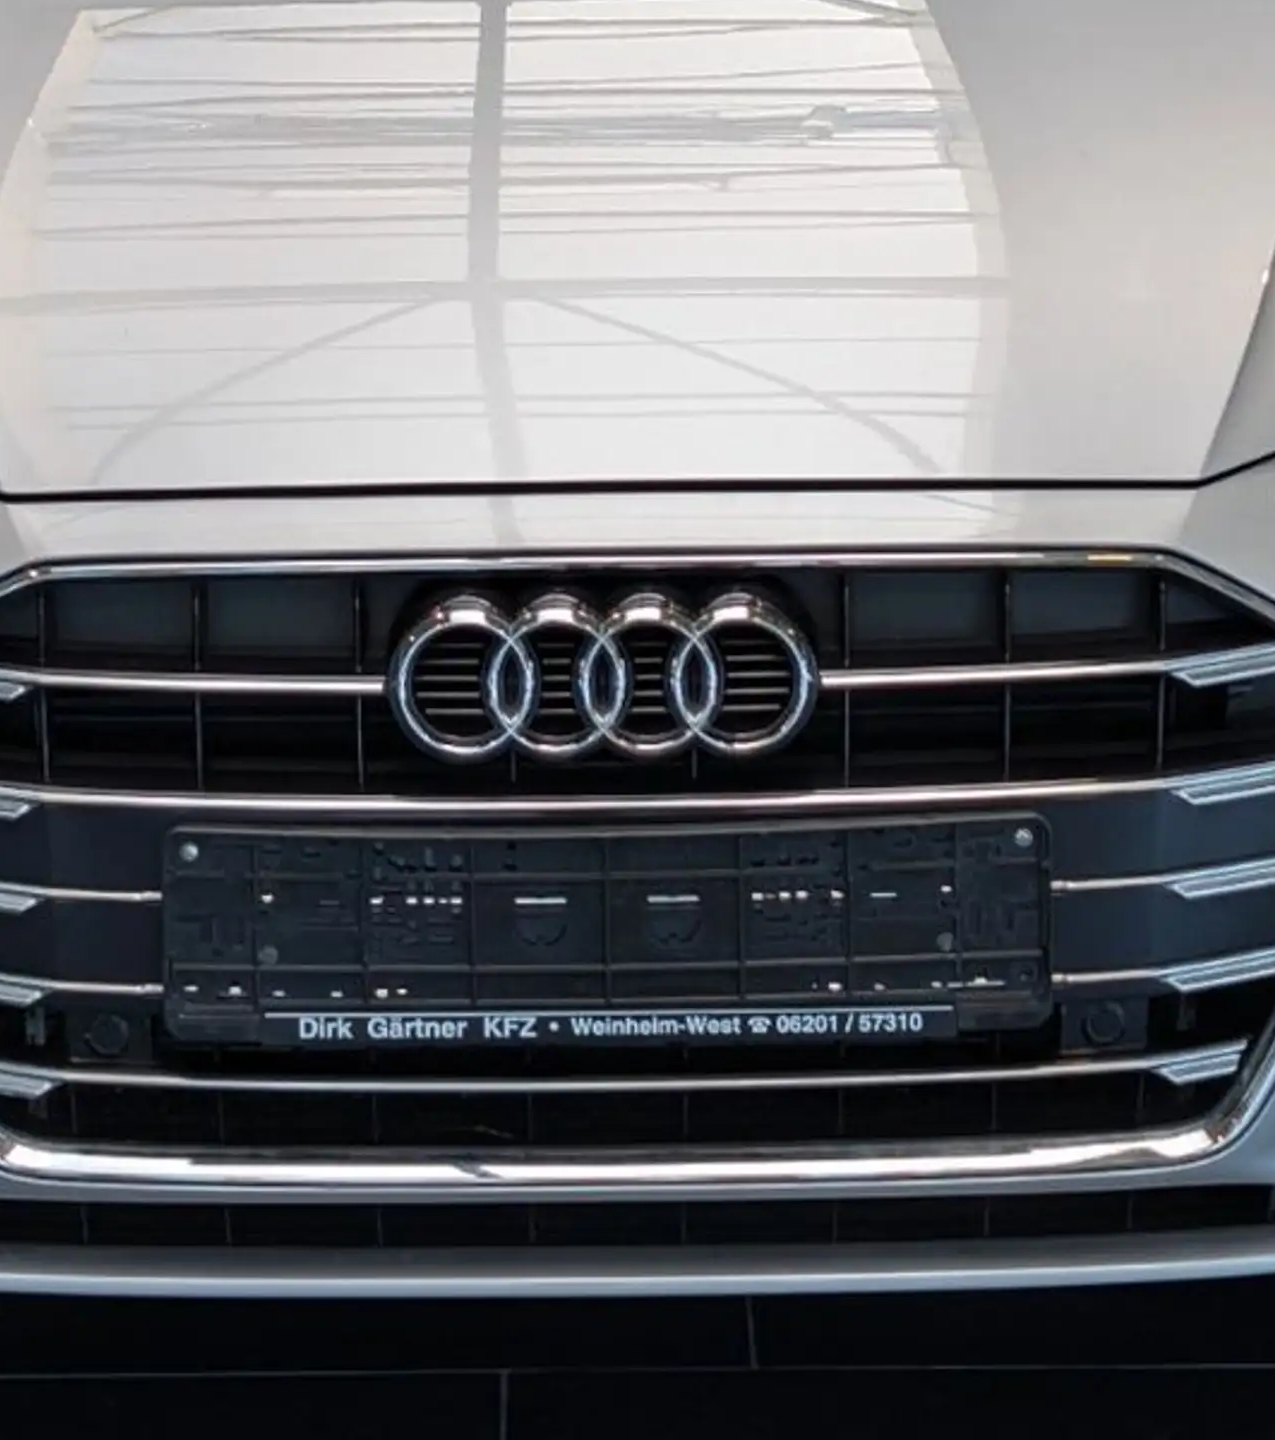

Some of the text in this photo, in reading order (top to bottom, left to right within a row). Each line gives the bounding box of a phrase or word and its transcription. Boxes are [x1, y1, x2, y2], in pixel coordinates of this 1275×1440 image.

[298, 1017, 353, 1039] Dirk
[367, 1017, 467, 1039] Gärtner
[483, 1017, 538, 1038] KFZ
[571, 1014, 741, 1036] Weinheim-West
[776, 1014, 838, 1034] 06201
[858, 1012, 922, 1033] 57310
